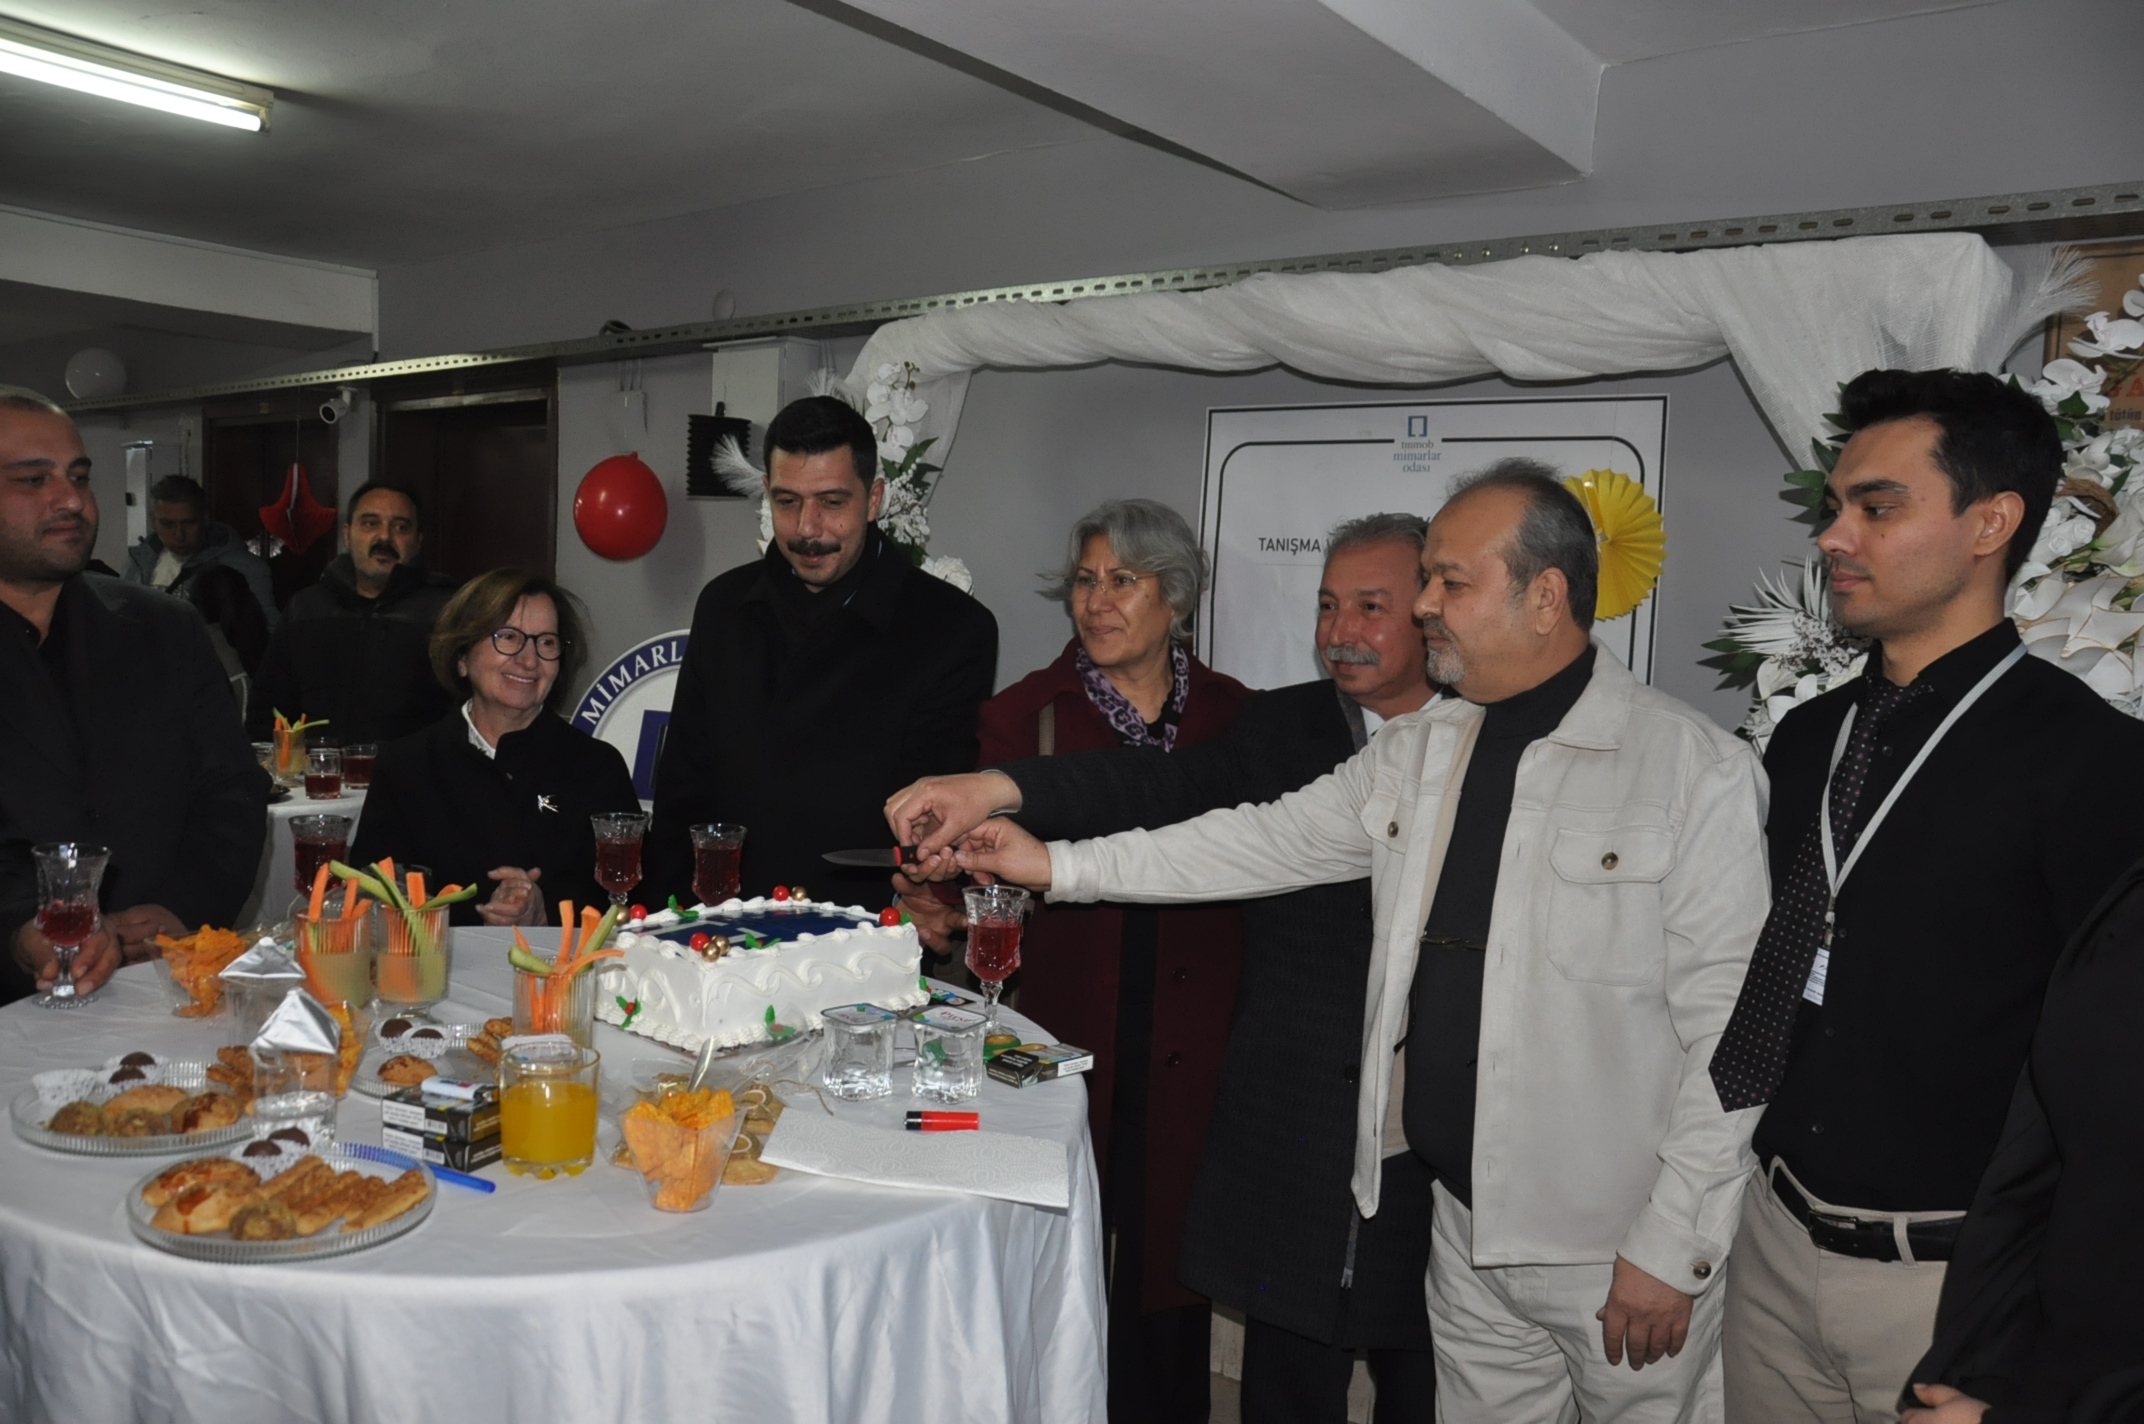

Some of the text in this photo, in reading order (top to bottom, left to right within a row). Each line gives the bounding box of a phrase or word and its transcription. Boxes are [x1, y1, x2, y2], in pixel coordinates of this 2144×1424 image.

[1401, 439, 1434, 449] tmmob
[1393, 449, 1442, 461] mimarlar
[1402, 461, 1431, 472] odası
[1258, 538, 1321, 555] TANIŞMA
